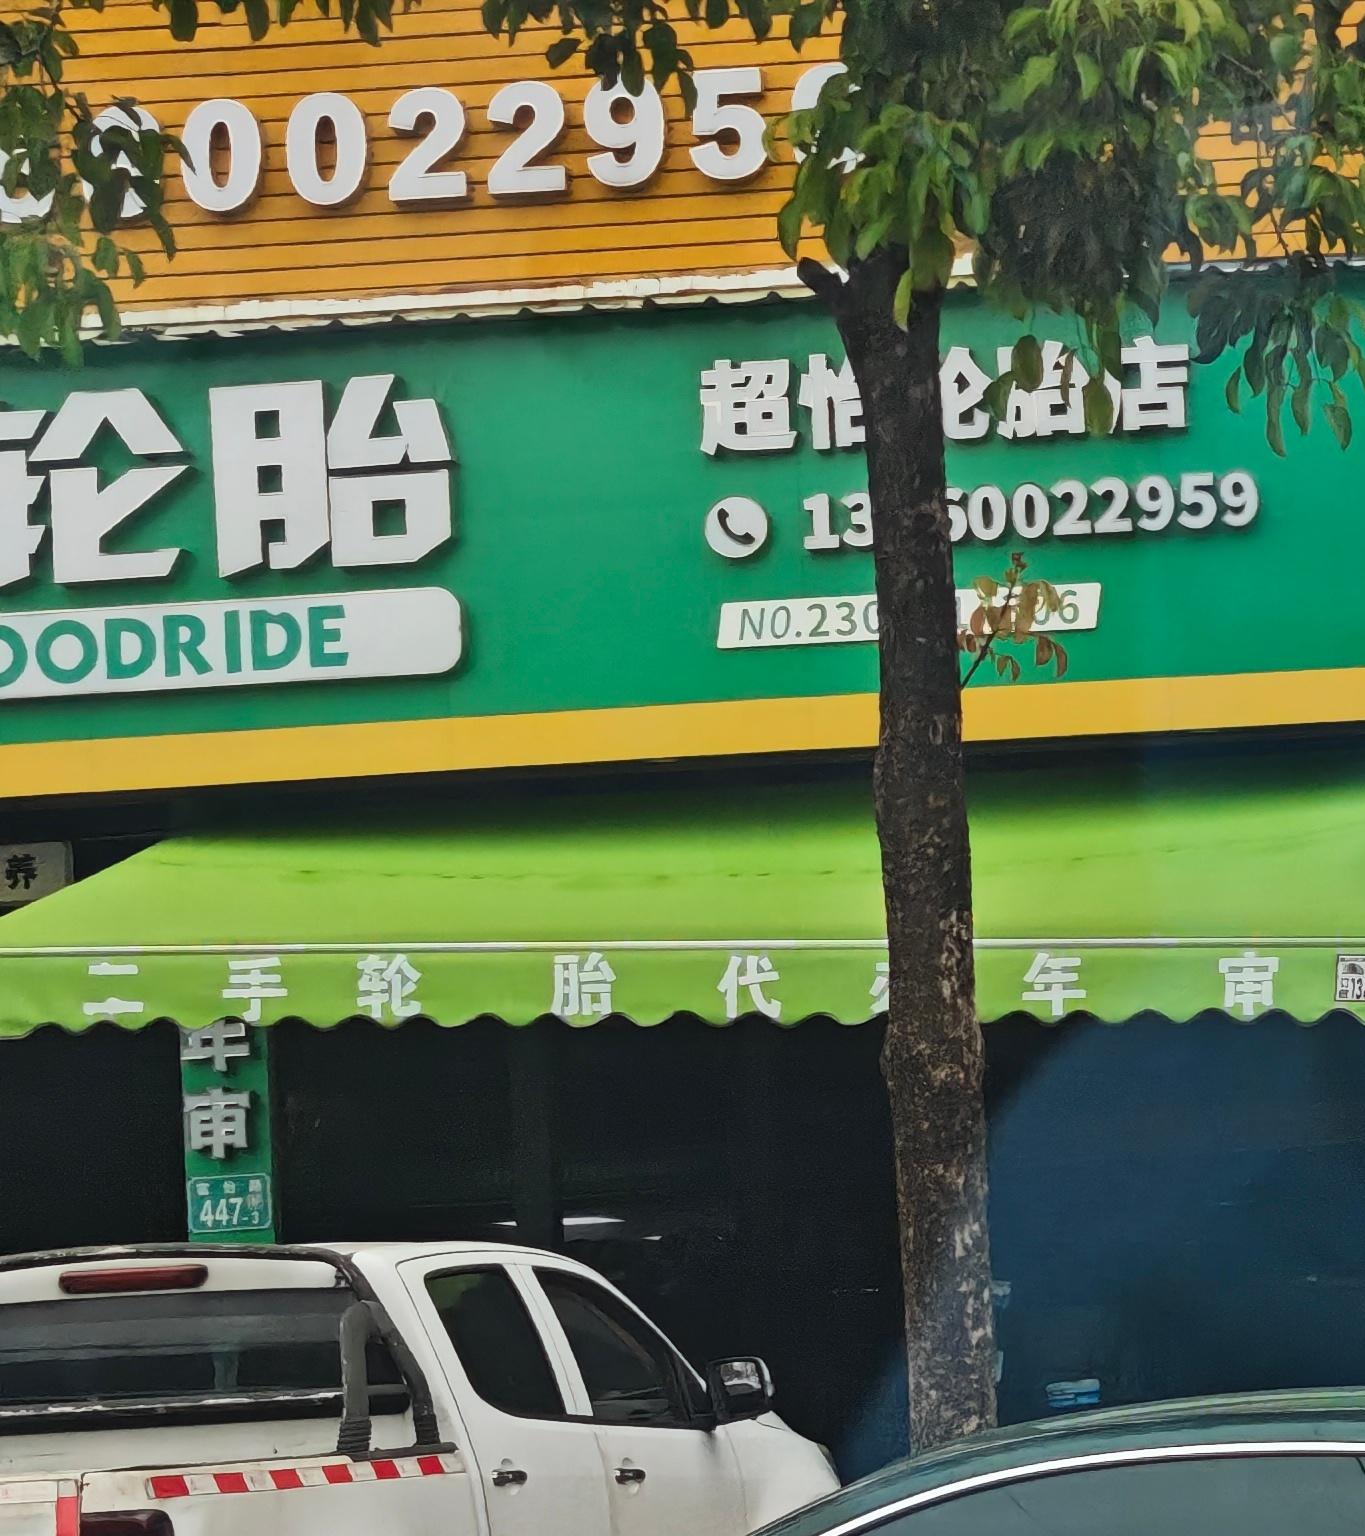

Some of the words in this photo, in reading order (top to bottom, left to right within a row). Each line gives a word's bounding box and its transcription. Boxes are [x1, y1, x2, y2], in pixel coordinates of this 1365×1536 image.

[0, 62, 866, 224] 002295
[700, 336, 1190, 456] 超怡轮胎店
[0, 374, 453, 588] 轮胎
[802, 472, 1259, 550] 1360022959
[181, 1017, 251, 1158] 年审
